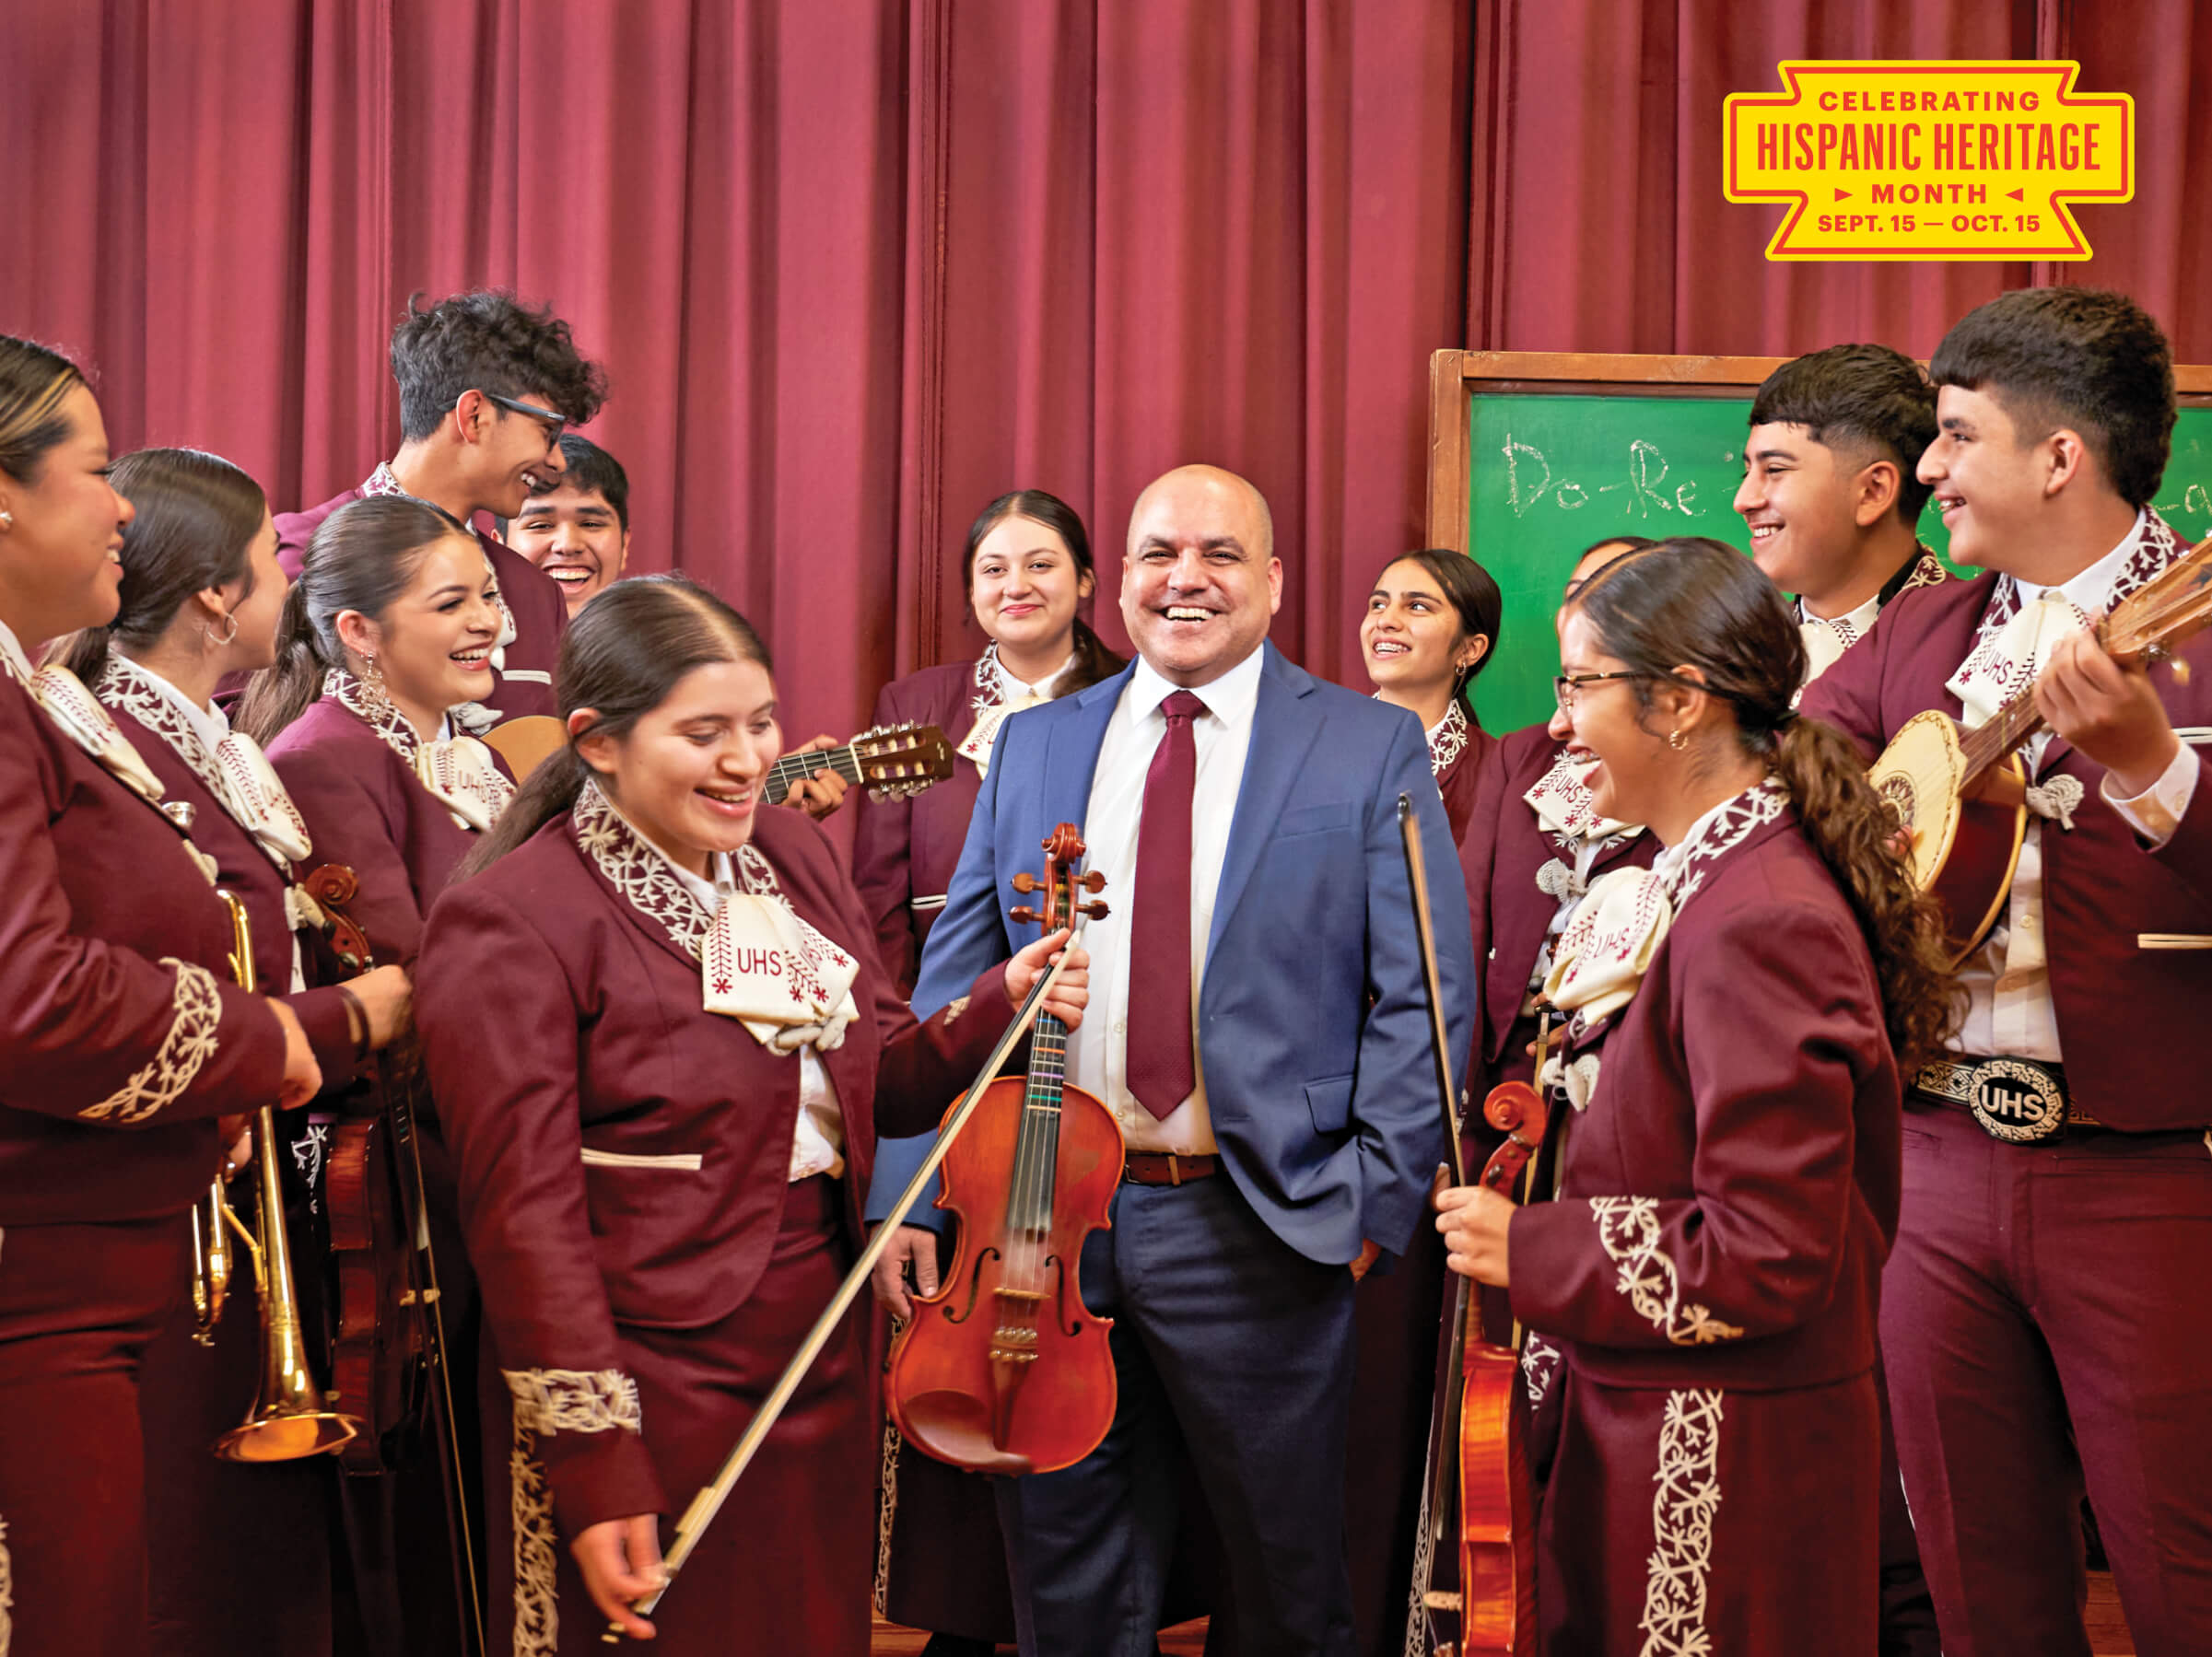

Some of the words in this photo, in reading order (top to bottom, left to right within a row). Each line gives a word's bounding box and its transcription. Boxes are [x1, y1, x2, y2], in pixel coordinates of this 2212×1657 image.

[1983, 648, 2013, 685] UHS
[1554, 774, 1584, 804] UHS
[737, 947, 782, 976] UHS
[1981, 1084, 2045, 1122] UHS
